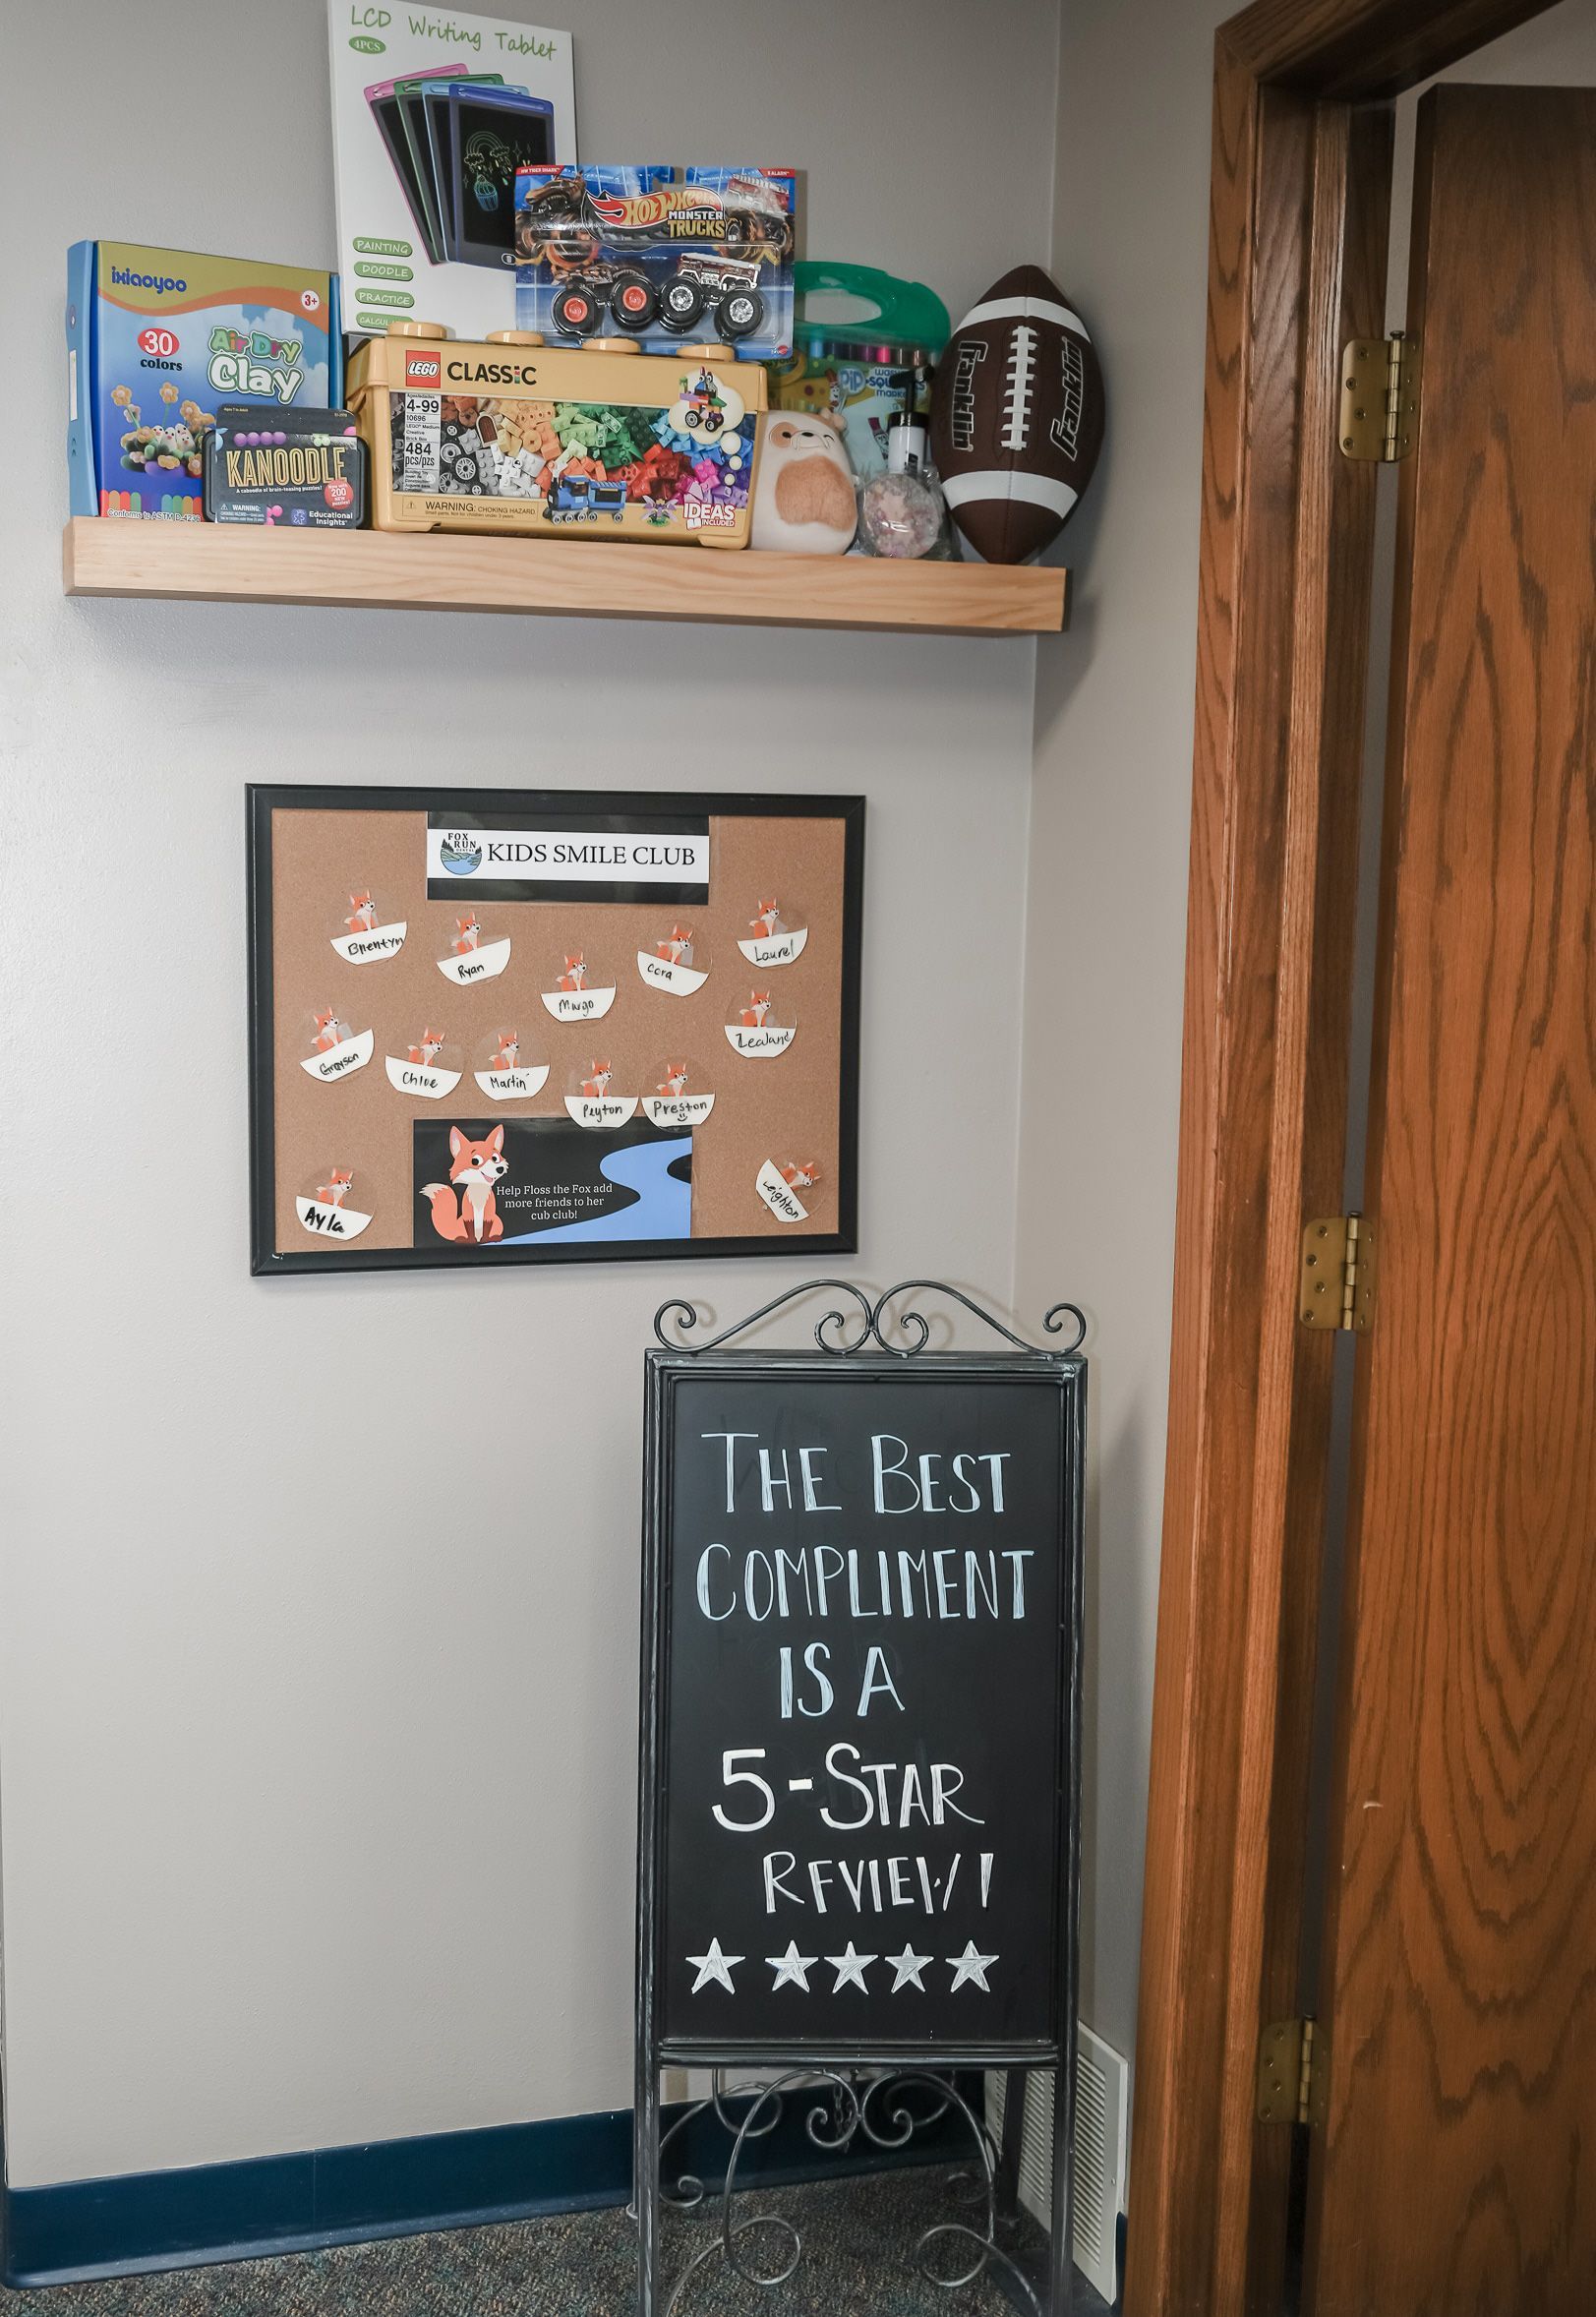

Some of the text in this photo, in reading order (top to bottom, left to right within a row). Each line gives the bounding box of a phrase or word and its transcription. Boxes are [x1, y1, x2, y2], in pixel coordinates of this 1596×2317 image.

[350, 5, 558, 60] LCD Writing Tablet
[353, 39, 381, 52] 4PCS
[621, 195, 660, 225] HOT
[669, 210, 723, 220] MONSTER
[668, 219, 726, 239] TRUCKS
[357, 240, 409, 255] PAINTING
[362, 265, 409, 277] DOODLE
[111, 266, 188, 295] ixiaoyoo
[304, 293, 319, 307] 3+
[359, 292, 411, 305] PRACTICE
[359, 316, 389, 326] CALCUL
[145, 329, 173, 356] 30
[210, 327, 301, 365] Air Dry
[140, 358, 183, 372] colors
[408, 360, 439, 378] LEGO
[209, 355, 302, 403] Clay
[406, 398, 440, 413] 4-99
[405, 443, 432, 455] 484
[226, 447, 347, 488] KANOODLE
[405, 454, 435, 468] pcs/pzs
[331, 488, 346, 497] 200
[108, 508, 143, 519] Conforms
[151, 511, 173, 521] ASTM
[309, 510, 353, 519] Educational
[425, 501, 476, 512] WARNING:
[683, 503, 735, 520] IDEAS
[448, 832, 468, 841] FOX
[454, 840, 476, 849] RUN
[487, 843, 695, 865] KIDS SMILE CLUB
[754, 939, 794, 962] Laurel
[457, 964, 485, 980] Ryan
[647, 963, 673, 981] Cora
[319, 1053, 359, 1075] Grayson
[402, 1071, 438, 1089] Chloe
[490, 1072, 529, 1091] Martin
[582, 1103, 622, 1122] Peyton
[653, 1099, 707, 1117] Preston
[497, 1183, 613, 1197] Help Floss the Fox add
[763, 1180, 798, 1218] Leighton
[504, 1199, 533, 1208] more
[535, 1197, 571, 1207] friends
[586, 1196, 605, 1206] her
[304, 1206, 345, 1233] Ayla
[531, 1209, 578, 1219] cub club!
[700, 1432, 1011, 1515] THE BEST
[696, 1543, 1034, 1622] COMPLIMENT
[779, 1641, 906, 1719] IS A
[711, 1742, 985, 1832] 5-STAR
